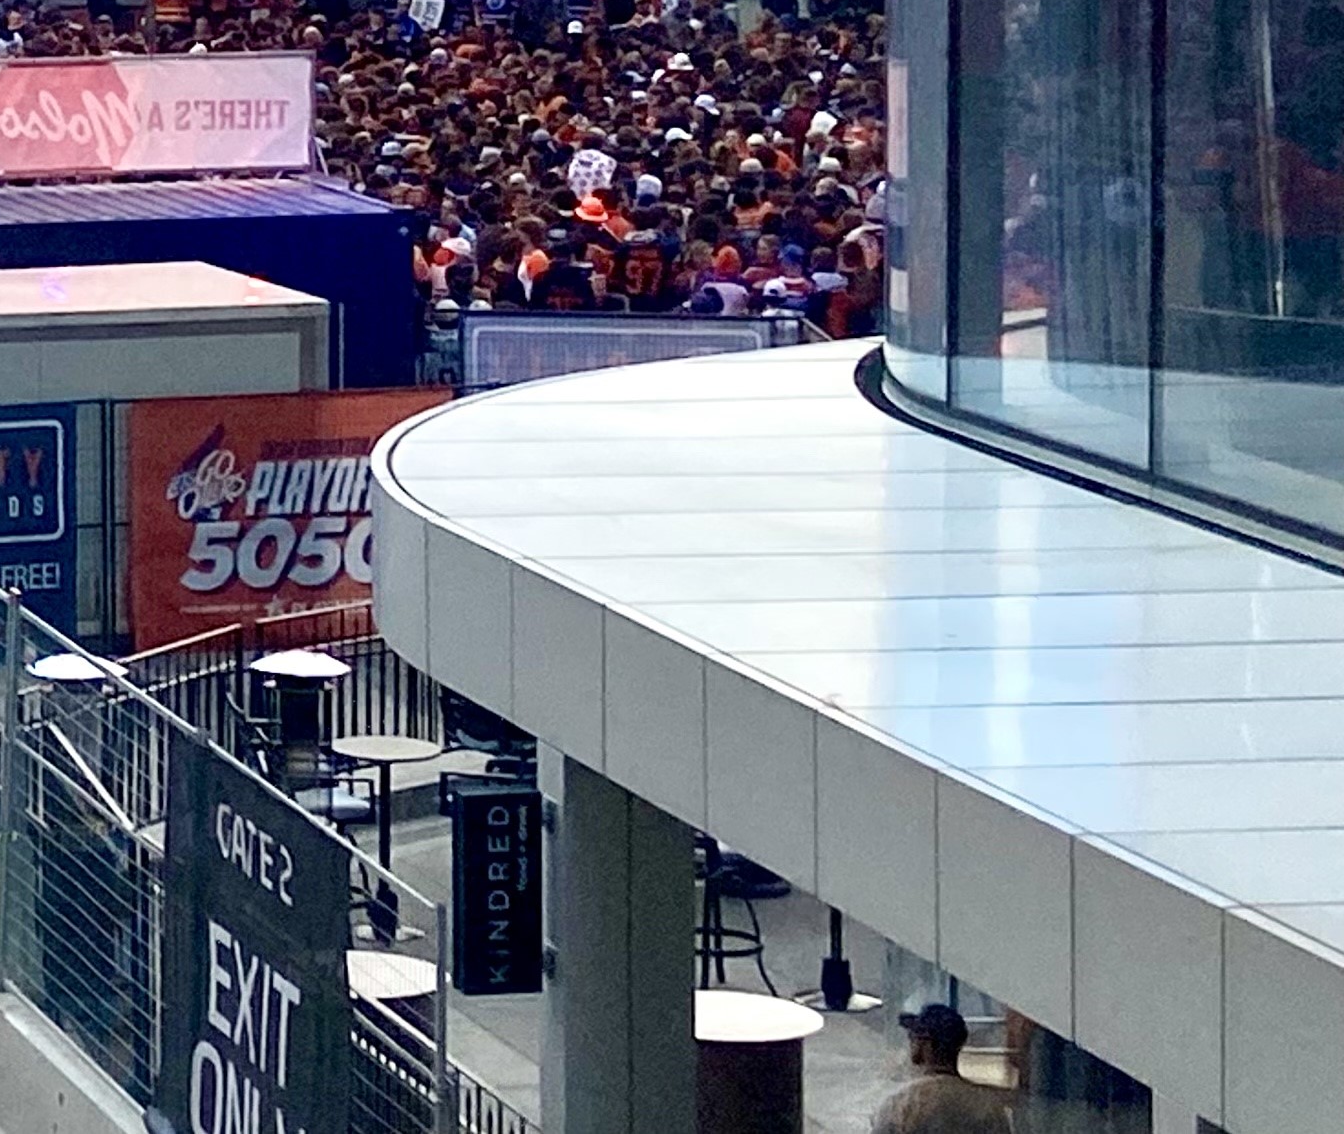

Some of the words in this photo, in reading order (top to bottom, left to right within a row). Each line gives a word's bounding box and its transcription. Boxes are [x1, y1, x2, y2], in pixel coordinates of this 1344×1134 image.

[216, 802, 274, 892] GATE
[279, 844, 294, 908] 2
[487, 805, 511, 984] KINDRED
[208, 919, 302, 1090] EXIT
[190, 1039, 306, 1134] ON
